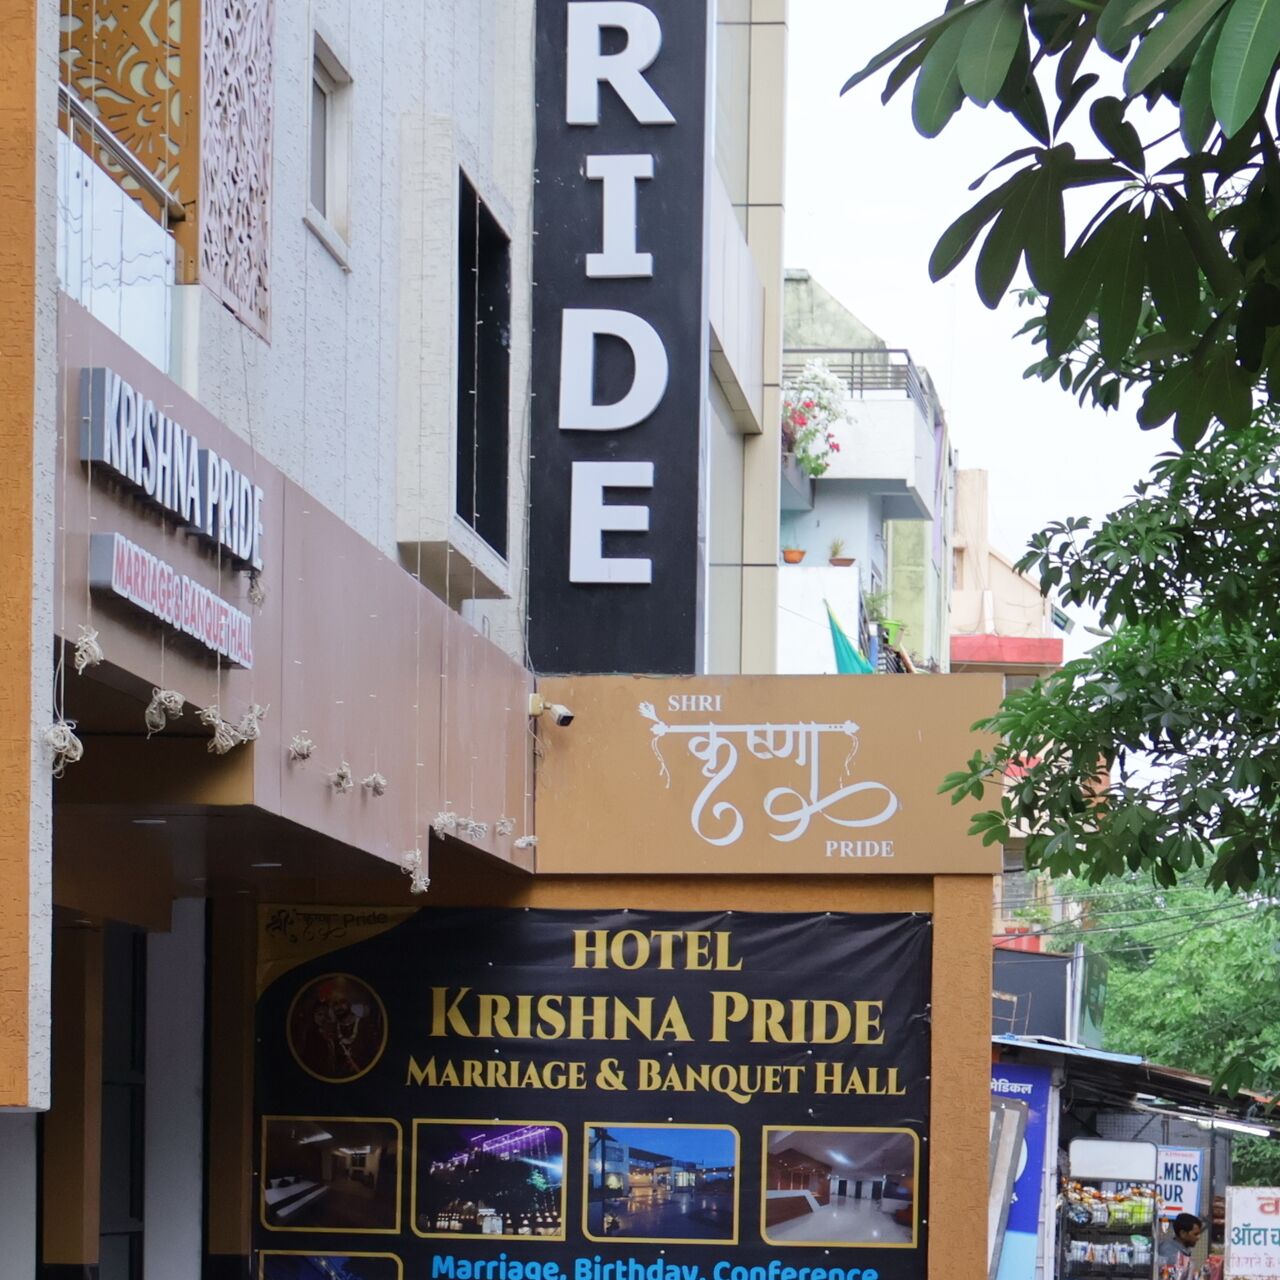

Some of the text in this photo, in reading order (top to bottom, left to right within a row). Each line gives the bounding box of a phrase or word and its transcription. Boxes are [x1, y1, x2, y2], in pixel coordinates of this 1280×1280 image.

[559, 1, 677, 584] RIDE
[103, 367, 263, 572] KRISHNA PRIDE
[112, 532, 173, 624] MARRIAGE
[181, 575, 228, 656] BANQUET
[228, 605, 252, 669] HALL
[668, 695, 723, 712] SHRI
[652, 720, 898, 846] कृष्णा
[825, 840, 895, 857] PRIDE
[343, 911, 389, 928] Pride
[573, 929, 743, 971] HOTEL
[429, 987, 886, 1045] KRISHNA PRIDE
[406, 1056, 906, 1104] MARRIAGE & BANQUET HALL
